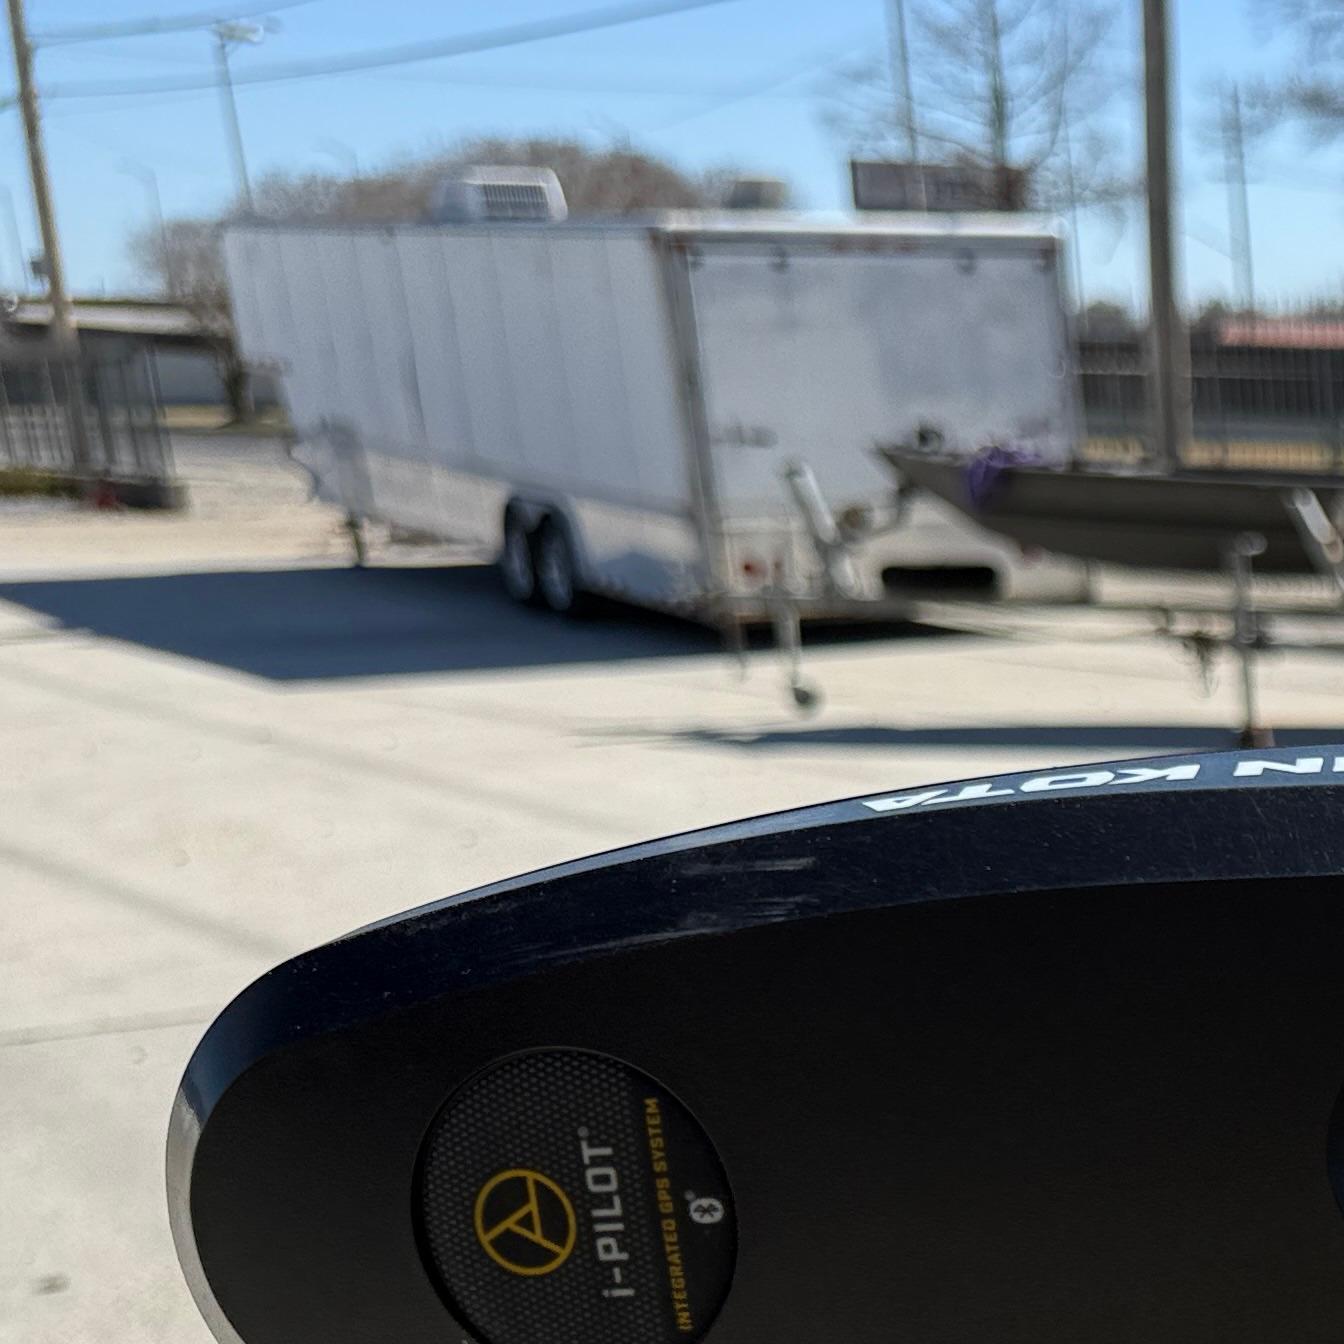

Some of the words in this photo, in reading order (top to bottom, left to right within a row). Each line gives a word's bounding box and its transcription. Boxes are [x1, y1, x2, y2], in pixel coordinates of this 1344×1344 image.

[863, 764, 1200, 812] KOTA
[644, 1098, 667, 1172] SYSTEM
[656, 1177, 674, 1213] GPS
[662, 1220, 693, 1329] INTEGRATED
